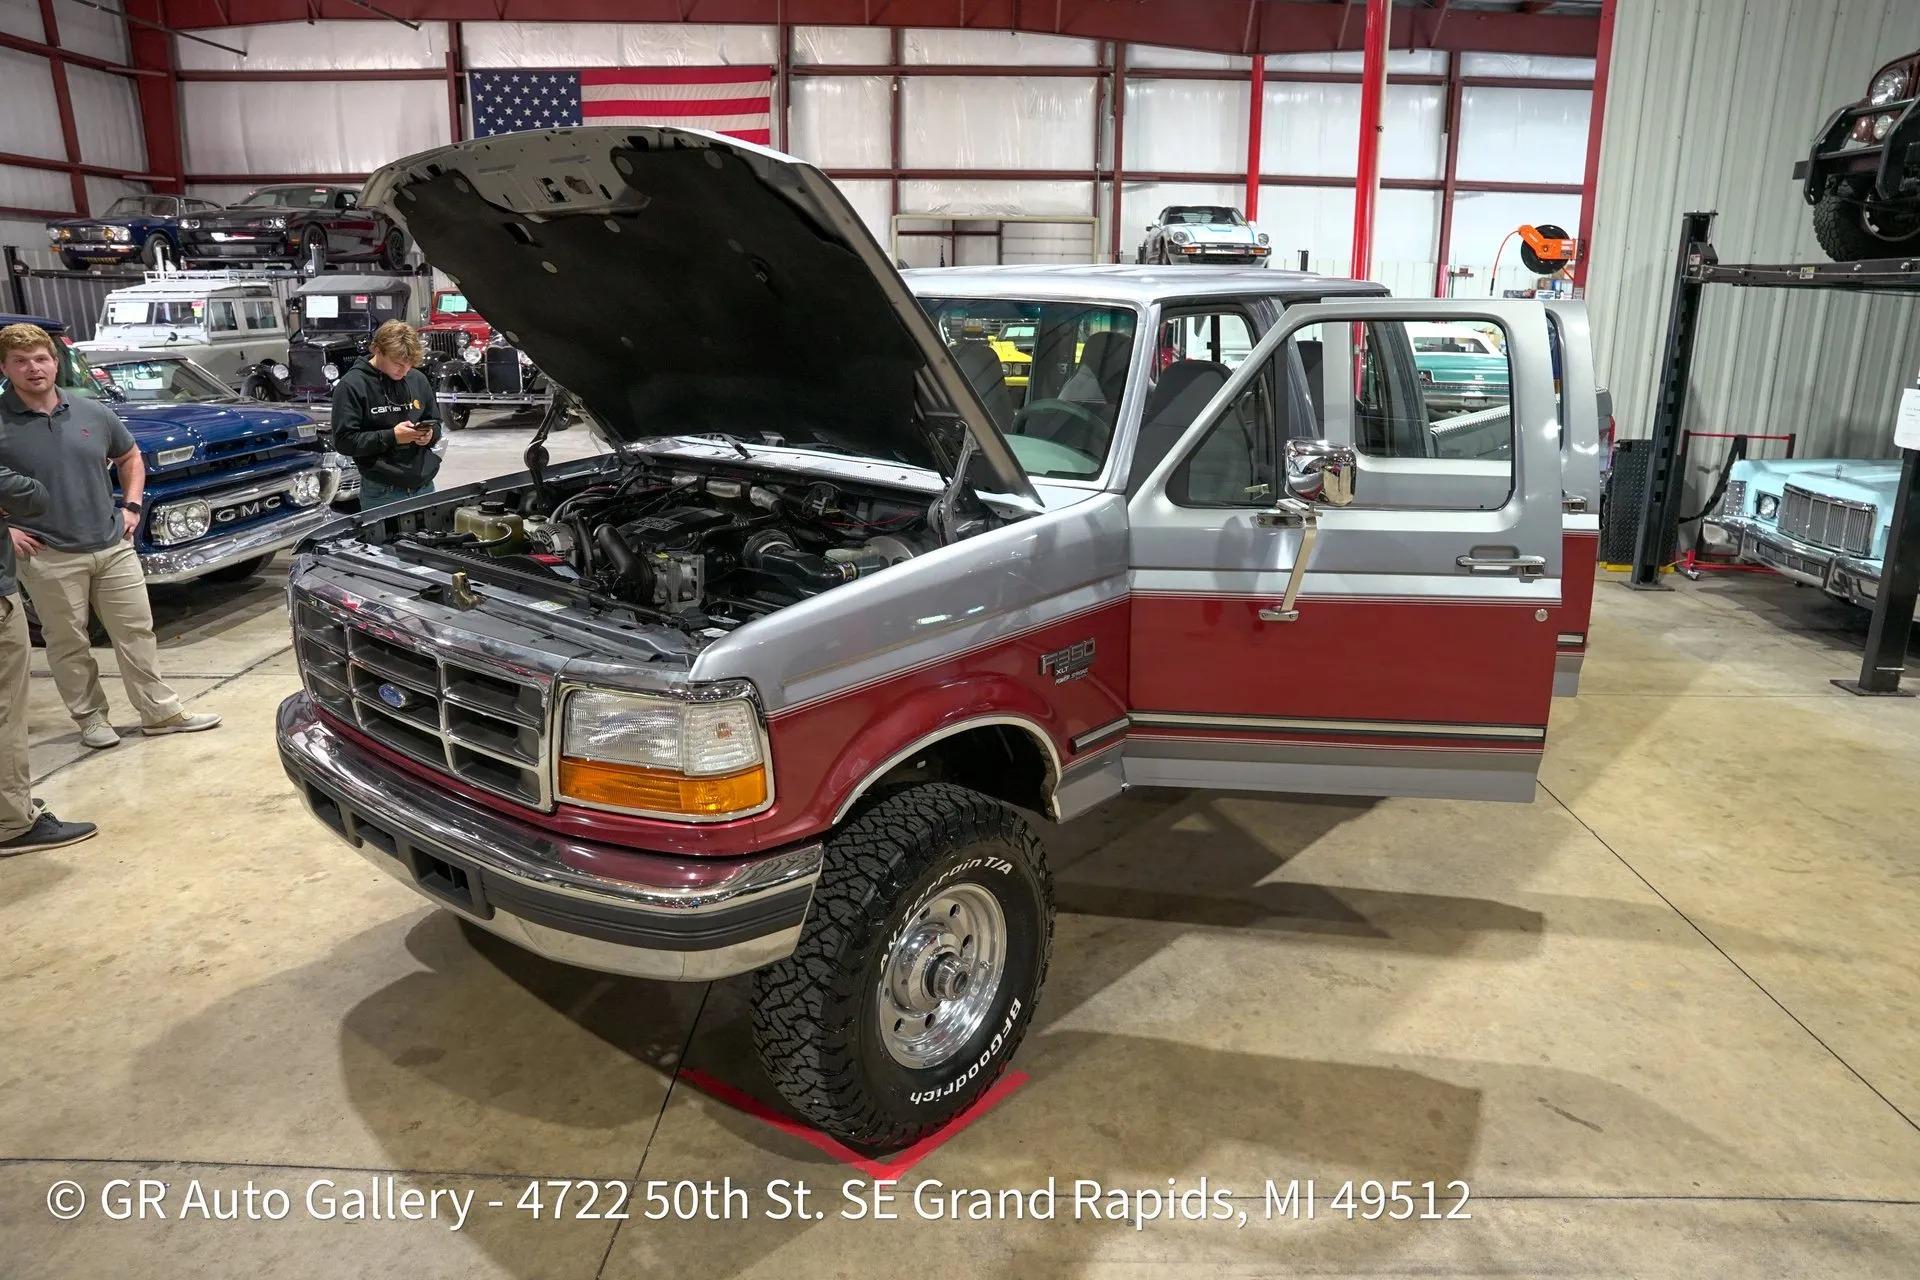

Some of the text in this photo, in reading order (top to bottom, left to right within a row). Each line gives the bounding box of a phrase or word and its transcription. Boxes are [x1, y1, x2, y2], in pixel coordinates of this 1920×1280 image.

[216, 495, 281, 522] GMC
[1056, 665, 1069, 675] XLT
[983, 856, 1013, 875] T/A
[910, 997, 1022, 1105] BFGoodrich
